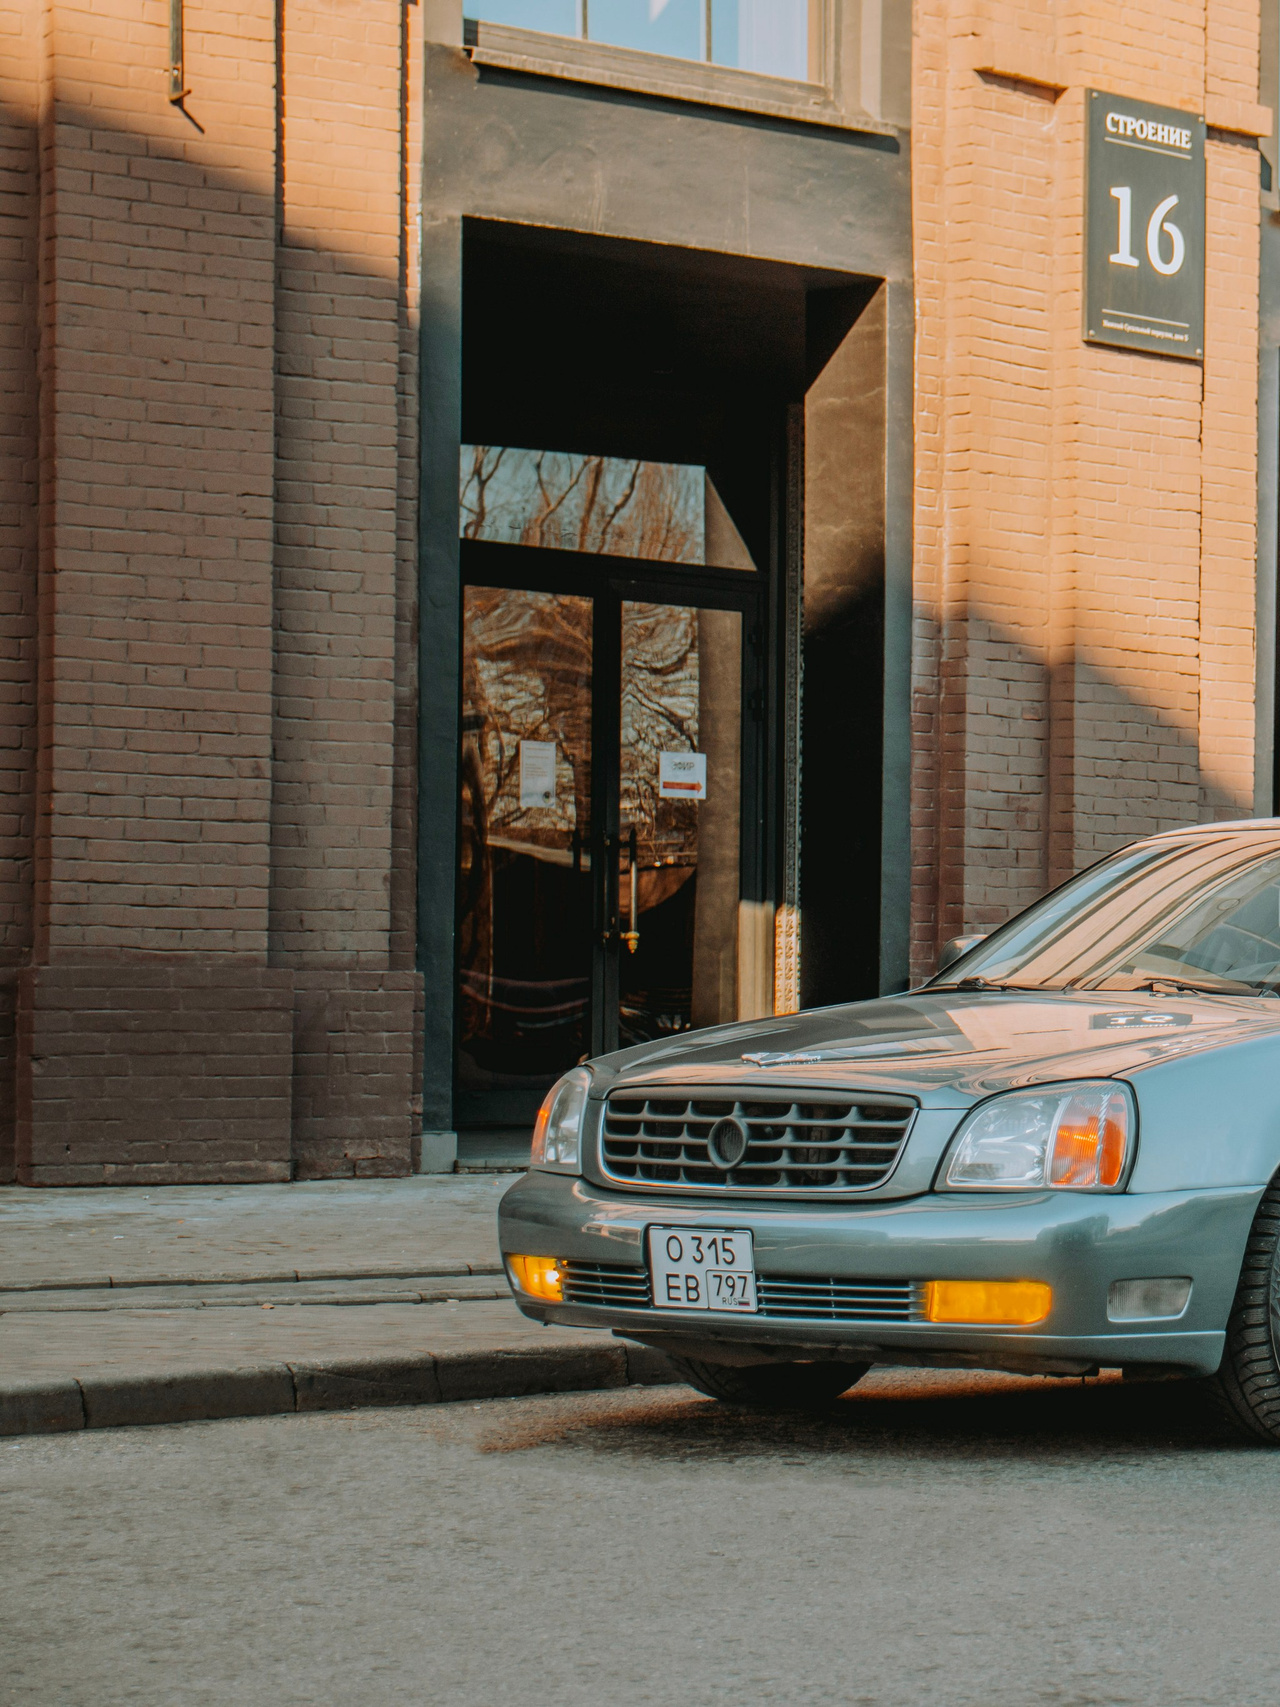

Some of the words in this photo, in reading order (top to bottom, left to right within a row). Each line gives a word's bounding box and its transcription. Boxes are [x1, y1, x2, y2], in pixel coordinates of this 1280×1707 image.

[1106, 112, 1192, 150] СТРОЕНИЕ
[1109, 186, 1185, 276] 16
[691, 1236, 735, 1265] 315
[666, 1273, 700, 1302] ЕВ
[713, 1274, 747, 1298] 797
[722, 1297, 738, 1306] RUS
